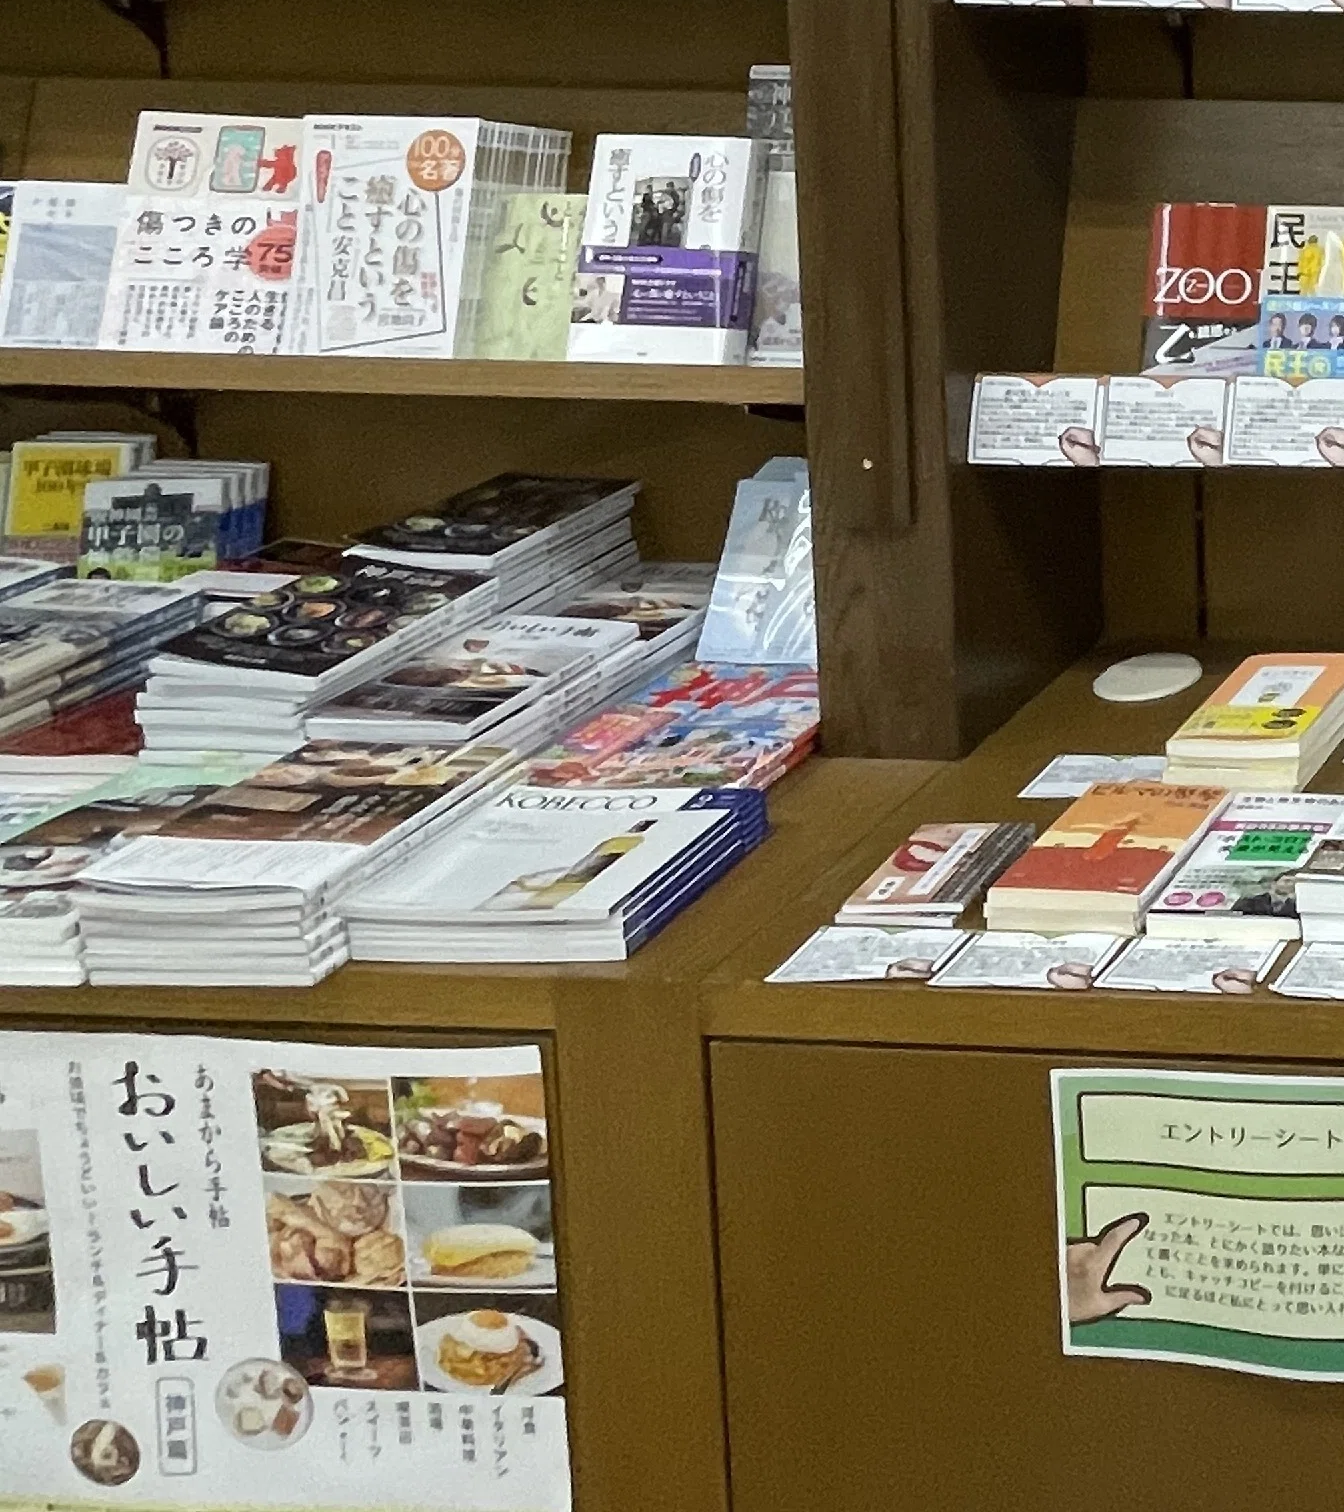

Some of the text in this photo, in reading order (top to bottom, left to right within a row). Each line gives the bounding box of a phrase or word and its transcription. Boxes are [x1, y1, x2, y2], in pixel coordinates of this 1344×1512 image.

[136, 209, 257, 236] 傷つきの
[335, 177, 360, 232] こと
[133, 243, 251, 272] こころ学
[257, 242, 294, 264] 75
[356, 175, 399, 323] 癒すという
[389, 189, 427, 308] 心の傷を
[1269, 212, 1306, 296] 民王
[194, 1063, 231, 1229] あまから手帖
[111, 1059, 210, 1366] おいしい手帖
